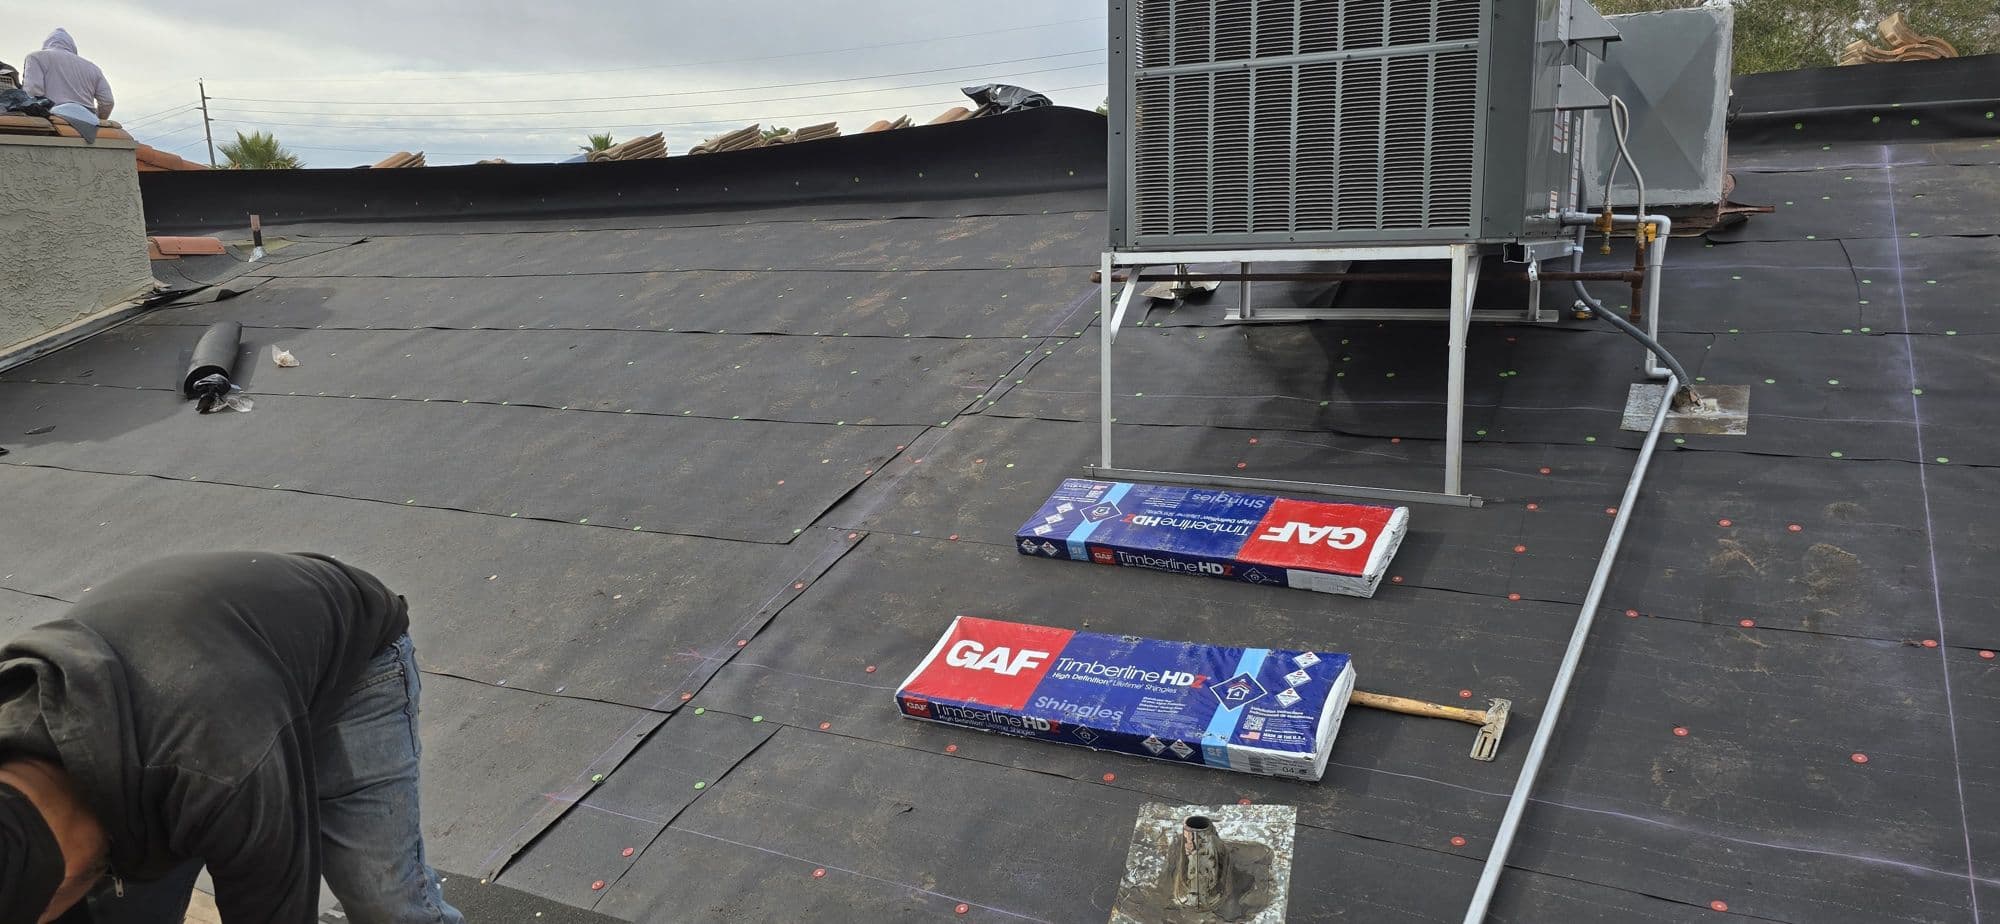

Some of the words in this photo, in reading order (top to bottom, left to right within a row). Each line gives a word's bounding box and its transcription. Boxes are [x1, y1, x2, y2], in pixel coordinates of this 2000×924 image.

[1192, 491, 1266, 509] Shingles
[1160, 516, 1250, 536] Timberline
[1258, 521, 1368, 550] GAF
[1094, 551, 1113, 560] GAF
[1116, 551, 1196, 572] Timberline
[945, 639, 1050, 676] GAF
[1055, 657, 1160, 683] Timberline
[1052, 672, 1071, 680] High
[1145, 684, 1177, 694] Shingles
[906, 702, 928, 711] GAF
[932, 701, 1022, 727] Timberline
[1035, 696, 1123, 720] Shingles
